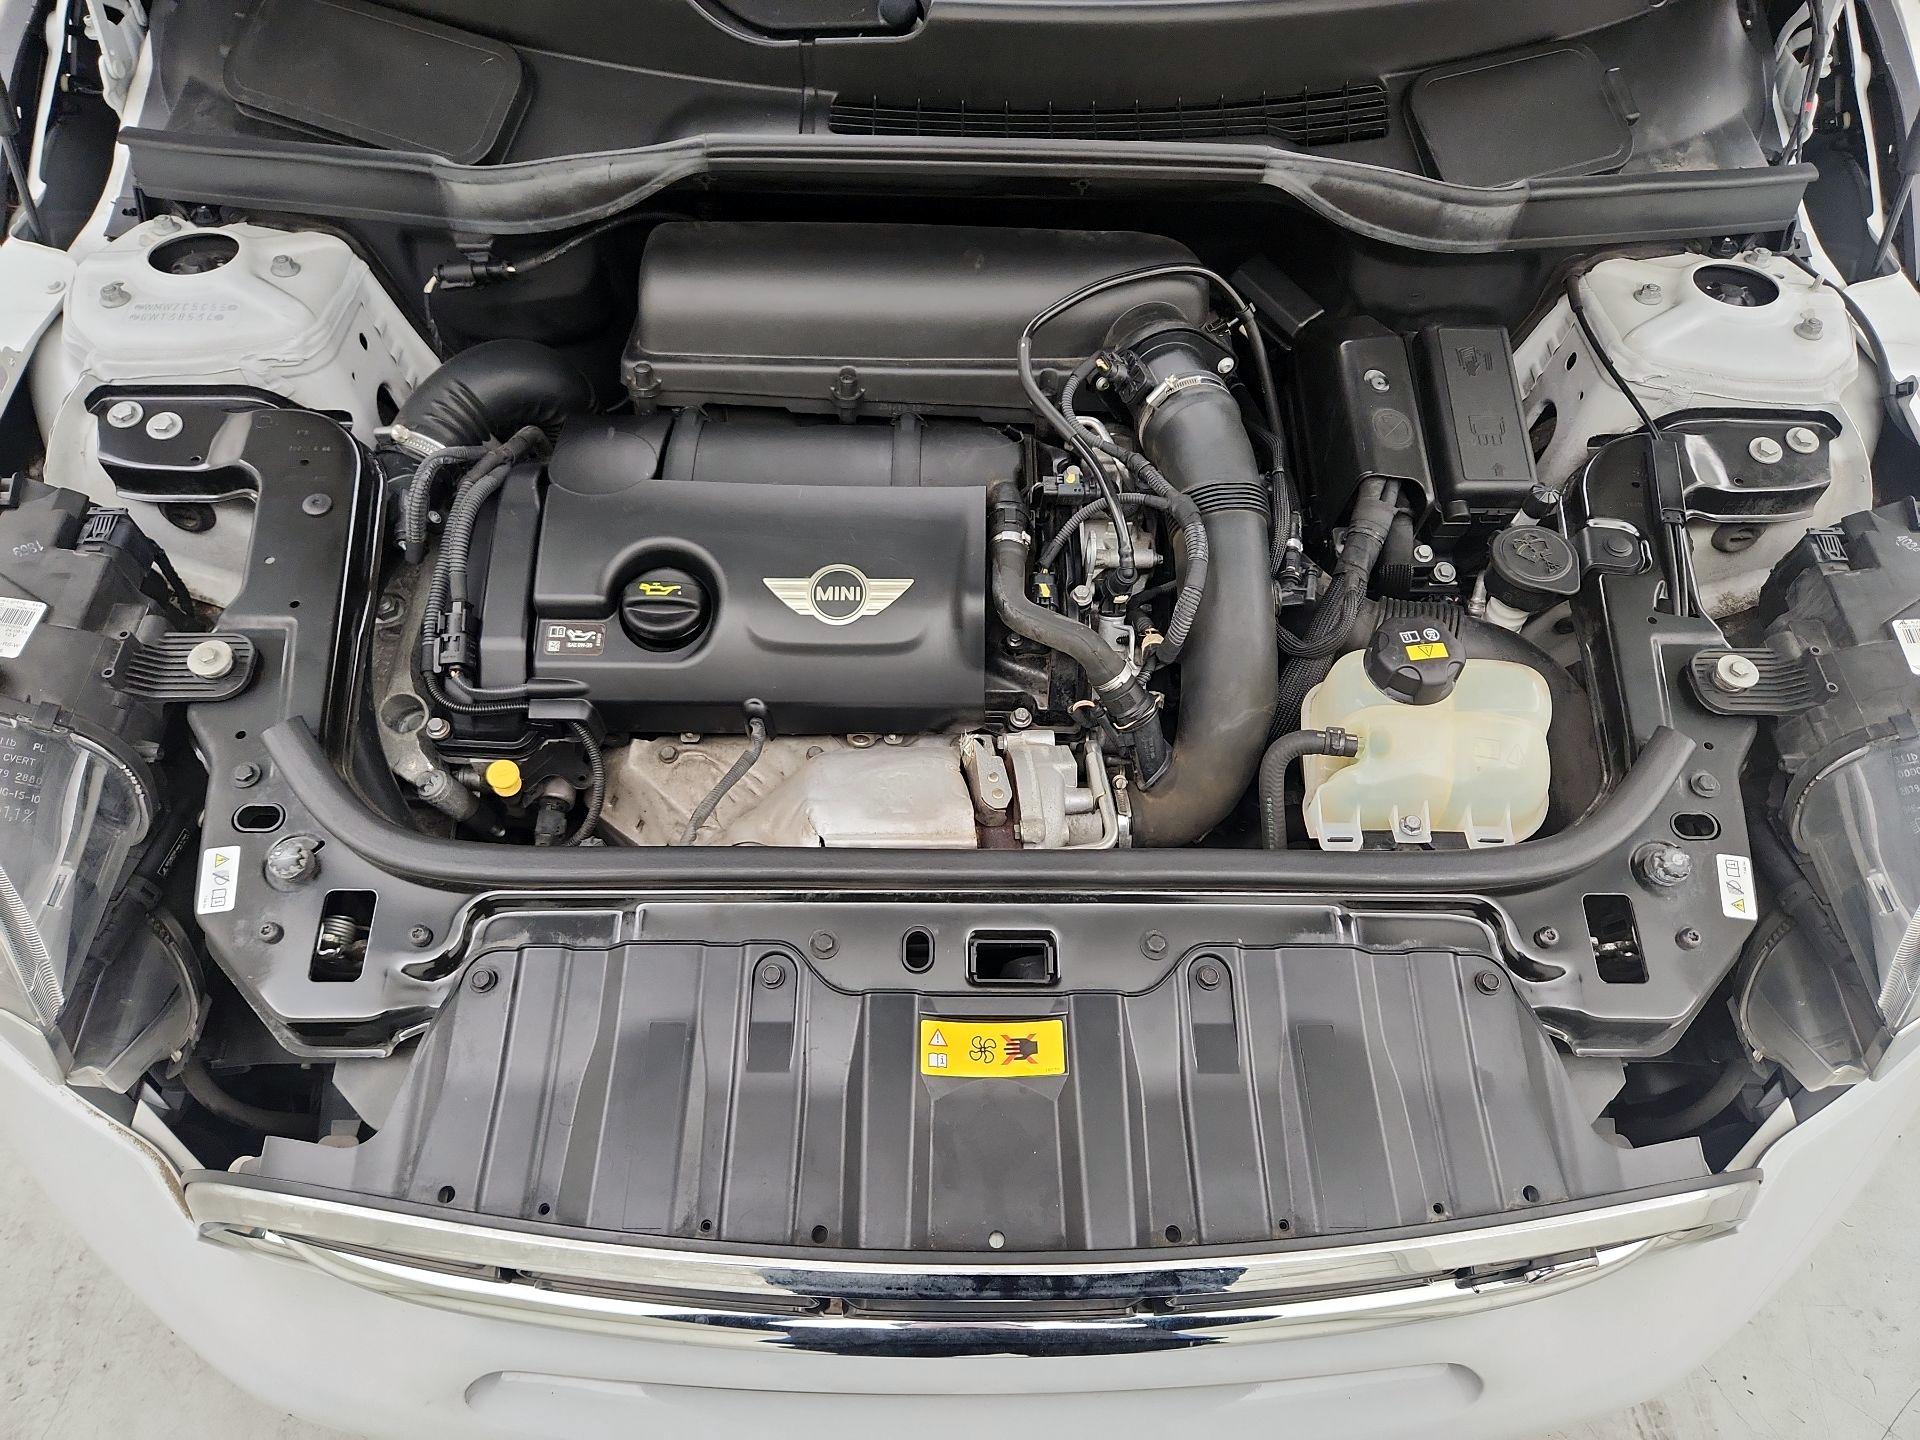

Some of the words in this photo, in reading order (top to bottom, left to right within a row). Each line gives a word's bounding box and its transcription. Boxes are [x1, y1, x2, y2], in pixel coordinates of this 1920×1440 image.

[815, 586, 861, 601] MINI
[33, 742, 46, 753] PL
[3, 753, 36, 766] CVERT
